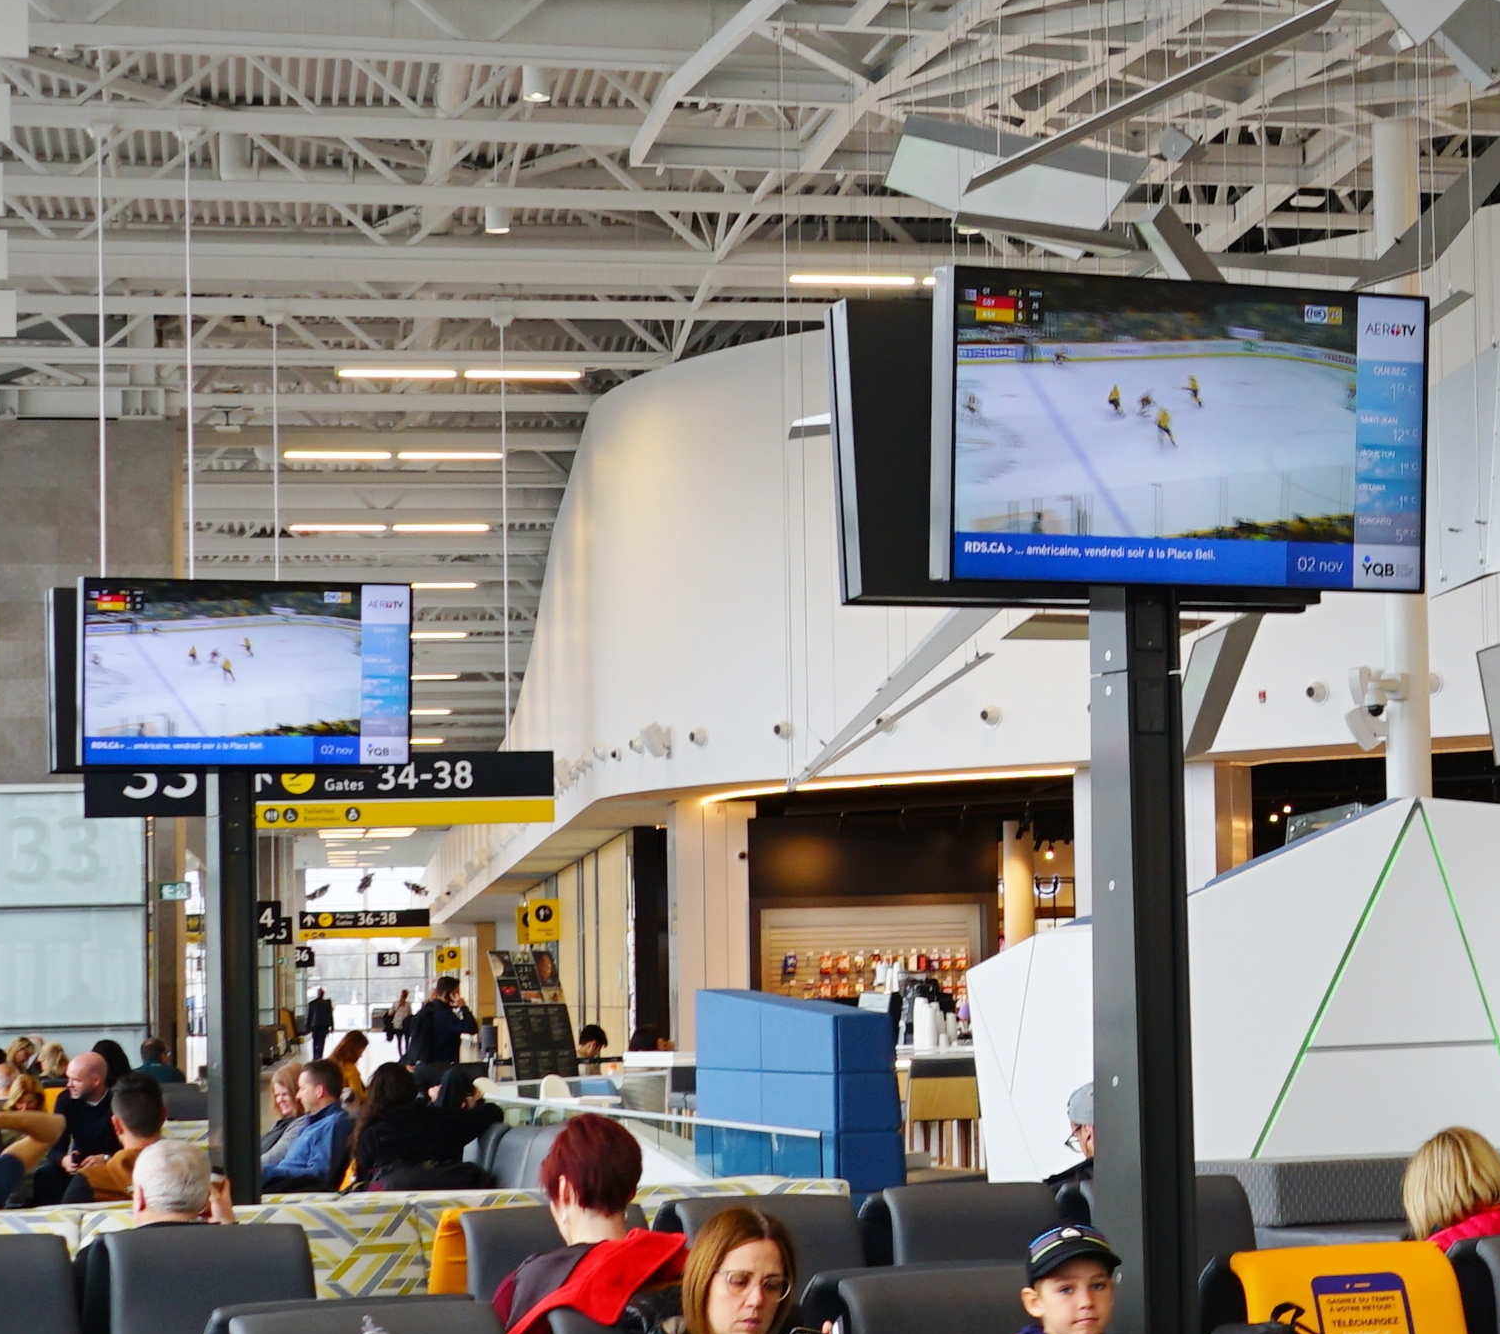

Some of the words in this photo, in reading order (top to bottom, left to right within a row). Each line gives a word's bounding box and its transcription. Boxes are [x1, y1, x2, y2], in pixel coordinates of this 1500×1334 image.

[964, 541, 1006, 554] RDS.CA
[1026, 543, 1082, 559] américaine,
[1084, 544, 1125, 558] vendredi
[1127, 546, 1146, 559] soir
[1156, 547, 1166, 559] la
[1167, 547, 1193, 560] Place
[1297, 556, 1316, 572] 02
[1318, 562, 1344, 573] nov
[1362, 562, 1395, 578] YQB
[320, 745, 334, 755] 02
[335, 747, 354, 756] nov
[367, 747, 390, 757] YQB
[324, 778, 365, 791] Gates
[377, 760, 474, 791] 34-38
[7, 815, 101, 884] 33
[258, 906, 275, 928] 4
[357, 912, 397, 926] 36-38
[294, 948, 310, 962] 36
[382, 953, 398, 965] 38
